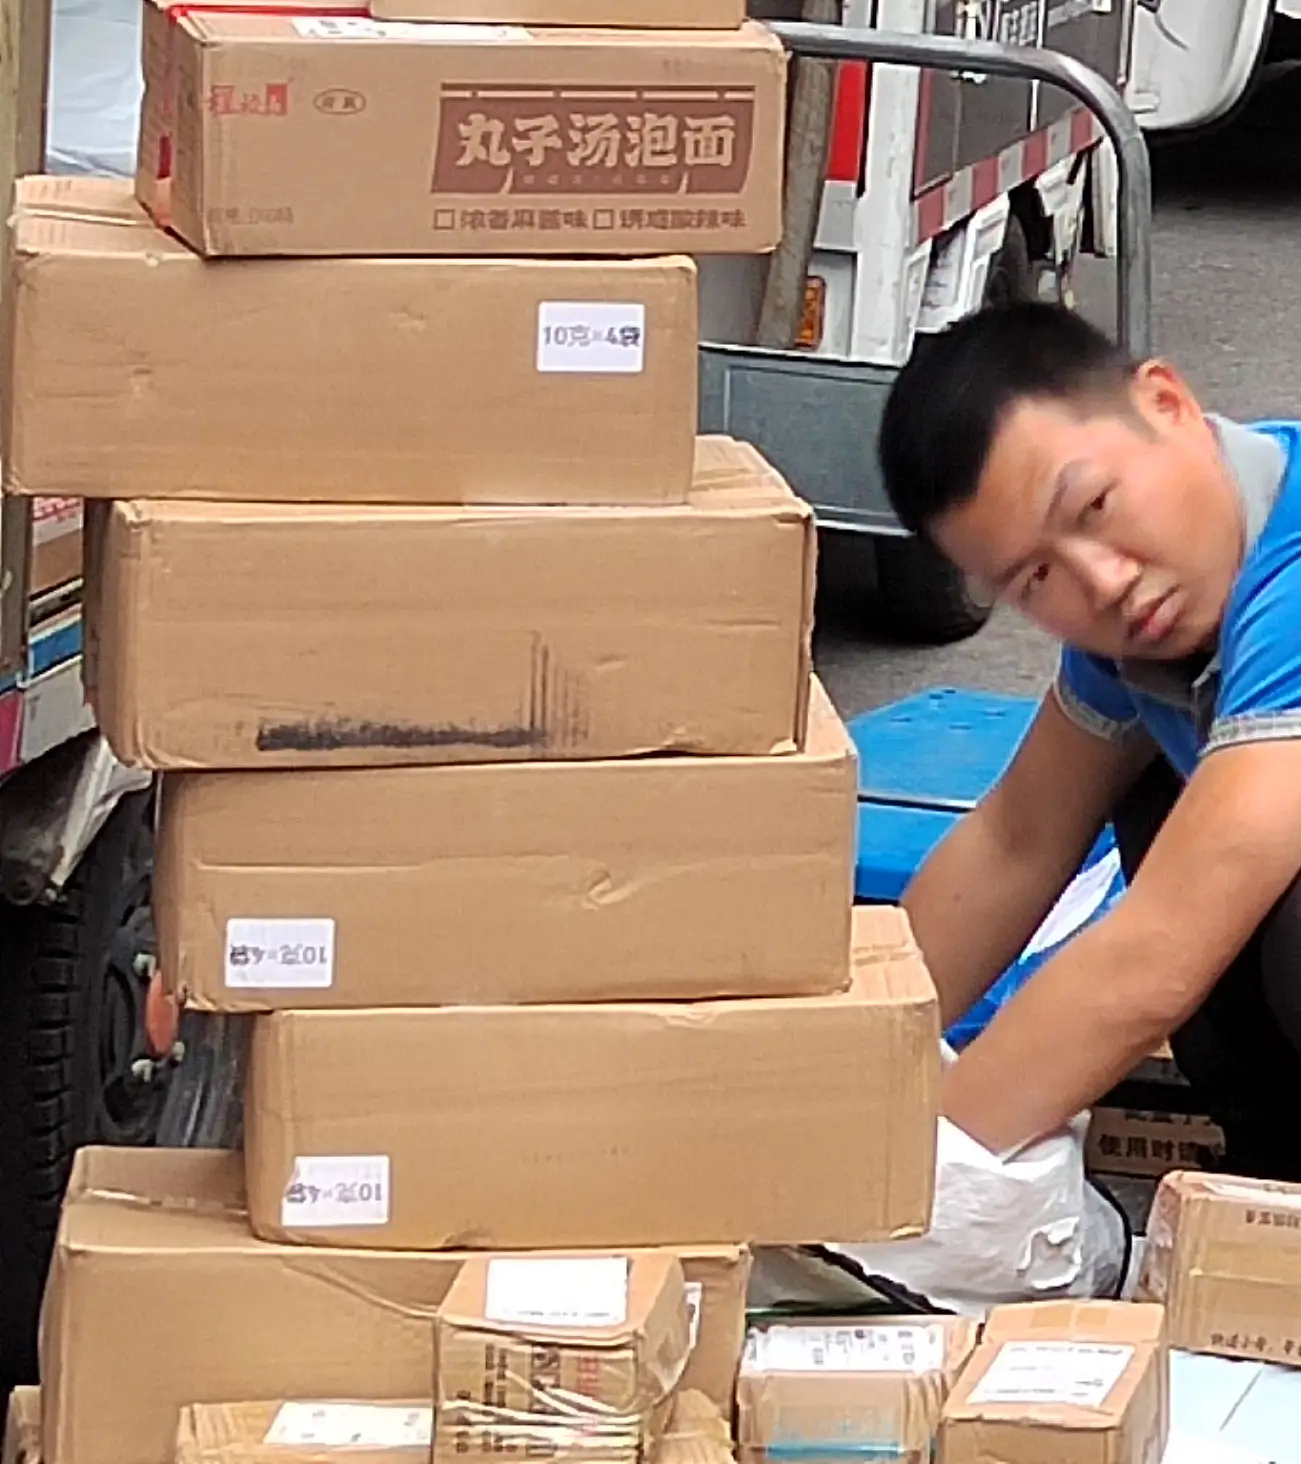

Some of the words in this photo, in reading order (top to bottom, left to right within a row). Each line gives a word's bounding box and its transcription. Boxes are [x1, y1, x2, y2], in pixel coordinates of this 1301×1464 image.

[455, 112, 735, 167] 丸子汤泡面
